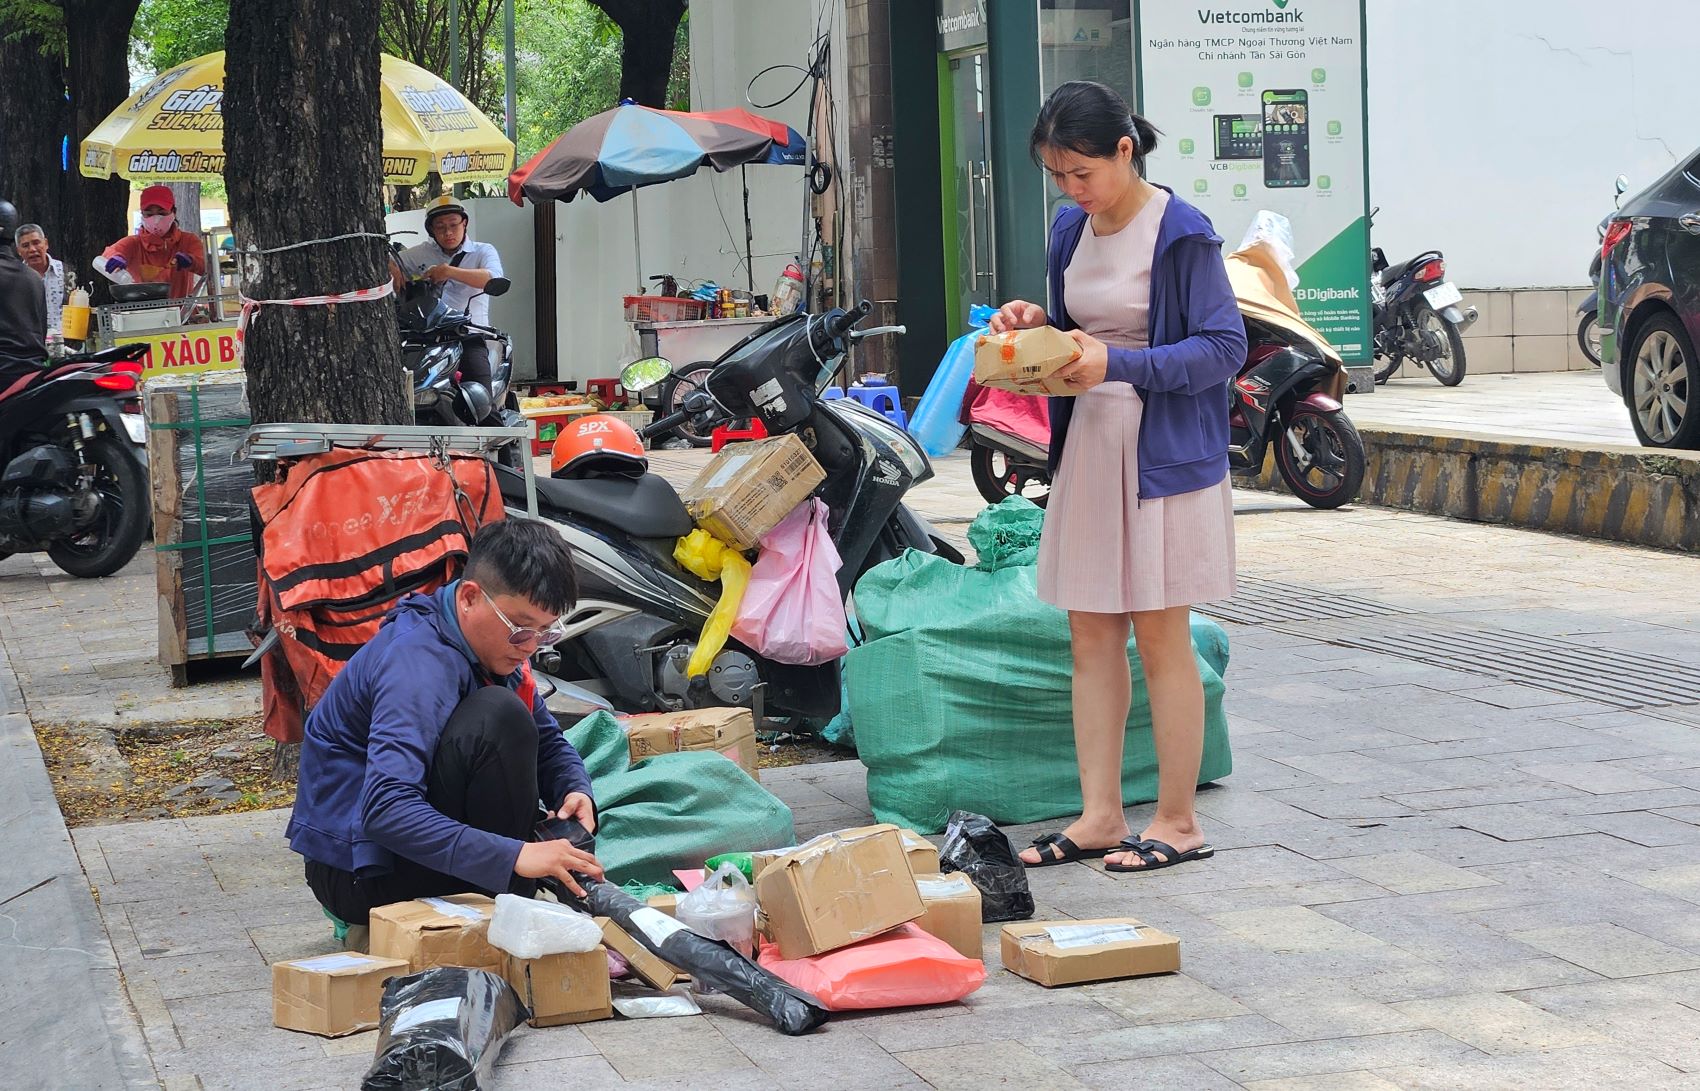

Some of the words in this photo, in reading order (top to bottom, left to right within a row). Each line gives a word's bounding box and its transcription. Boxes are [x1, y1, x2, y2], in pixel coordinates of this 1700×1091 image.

[937, 8, 980, 34] Vietcombank
[1198, 8, 1304, 24] Vietcombank
[1149, 39, 1174, 49] Ngân
[1178, 39, 1200, 48] hàng
[1205, 38, 1234, 47] TMCP
[1238, 38, 1266, 48] Ngoại
[1269, 37, 1305, 47] Thương
[1309, 36, 1327, 46] Việt
[1331, 37, 1353, 45] Nam
[1198, 51, 1214, 60] Chi
[1217, 51, 1246, 60] nhánh
[1269, 50, 1283, 59] Sài
[1286, 50, 1306, 59] Gòn
[383, 157, 416, 177] ẠNH
[1209, 163, 1228, 171] VCB
[1307, 287, 1359, 302] Digibank
[160, 333, 211, 368] XÀO
[579, 421, 609, 434] SPX
[872, 475, 900, 487] HONDA
